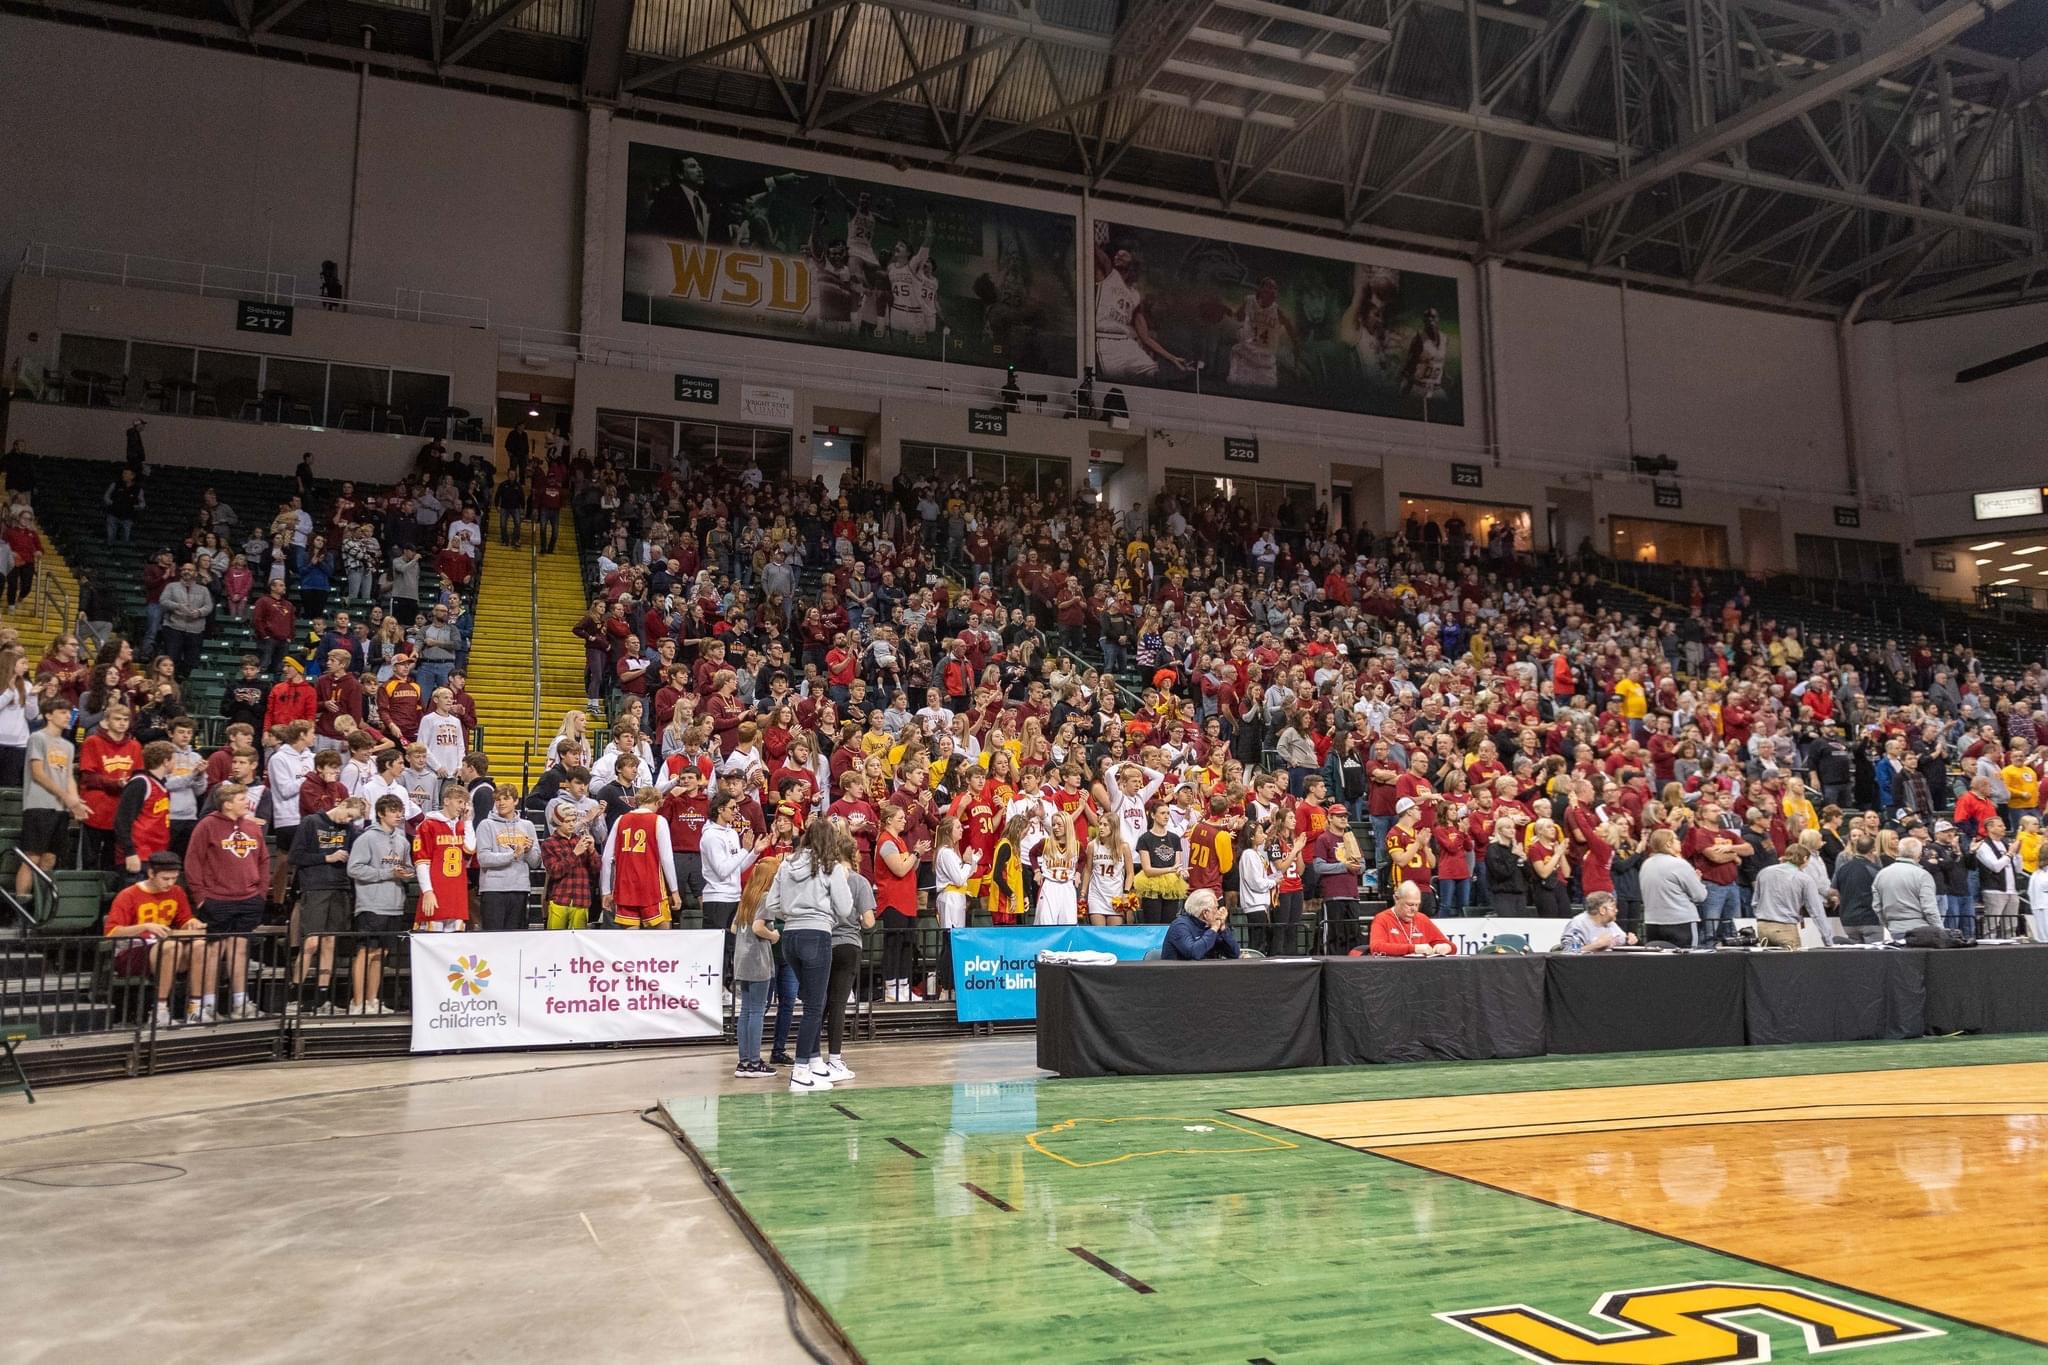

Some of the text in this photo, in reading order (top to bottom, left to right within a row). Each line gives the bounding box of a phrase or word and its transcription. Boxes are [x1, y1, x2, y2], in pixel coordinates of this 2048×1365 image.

[666, 240, 812, 315] WSU
[893, 285, 910, 297] 45
[246, 305, 286, 317] Section
[245, 316, 285, 329] 217
[682, 378, 713, 388] Section
[681, 387, 713, 400] 218
[975, 412, 1002, 421] Section
[975, 421, 1002, 431] 219
[1230, 448, 1254, 459] 220
[1457, 474, 1478, 484] 221
[979, 817, 994, 834] 34
[1134, 819, 1141, 830] 5
[621, 828, 647, 853] 12
[1191, 842, 1210, 868] 20
[443, 846, 463, 878] 8
[1100, 864, 1115, 877] 14
[569, 956, 680, 974] the center
[588, 974, 660, 993] for the
[439, 998, 498, 1015] dayton
[546, 994, 700, 1014] female athlete
[428, 1012, 507, 1029] children's
